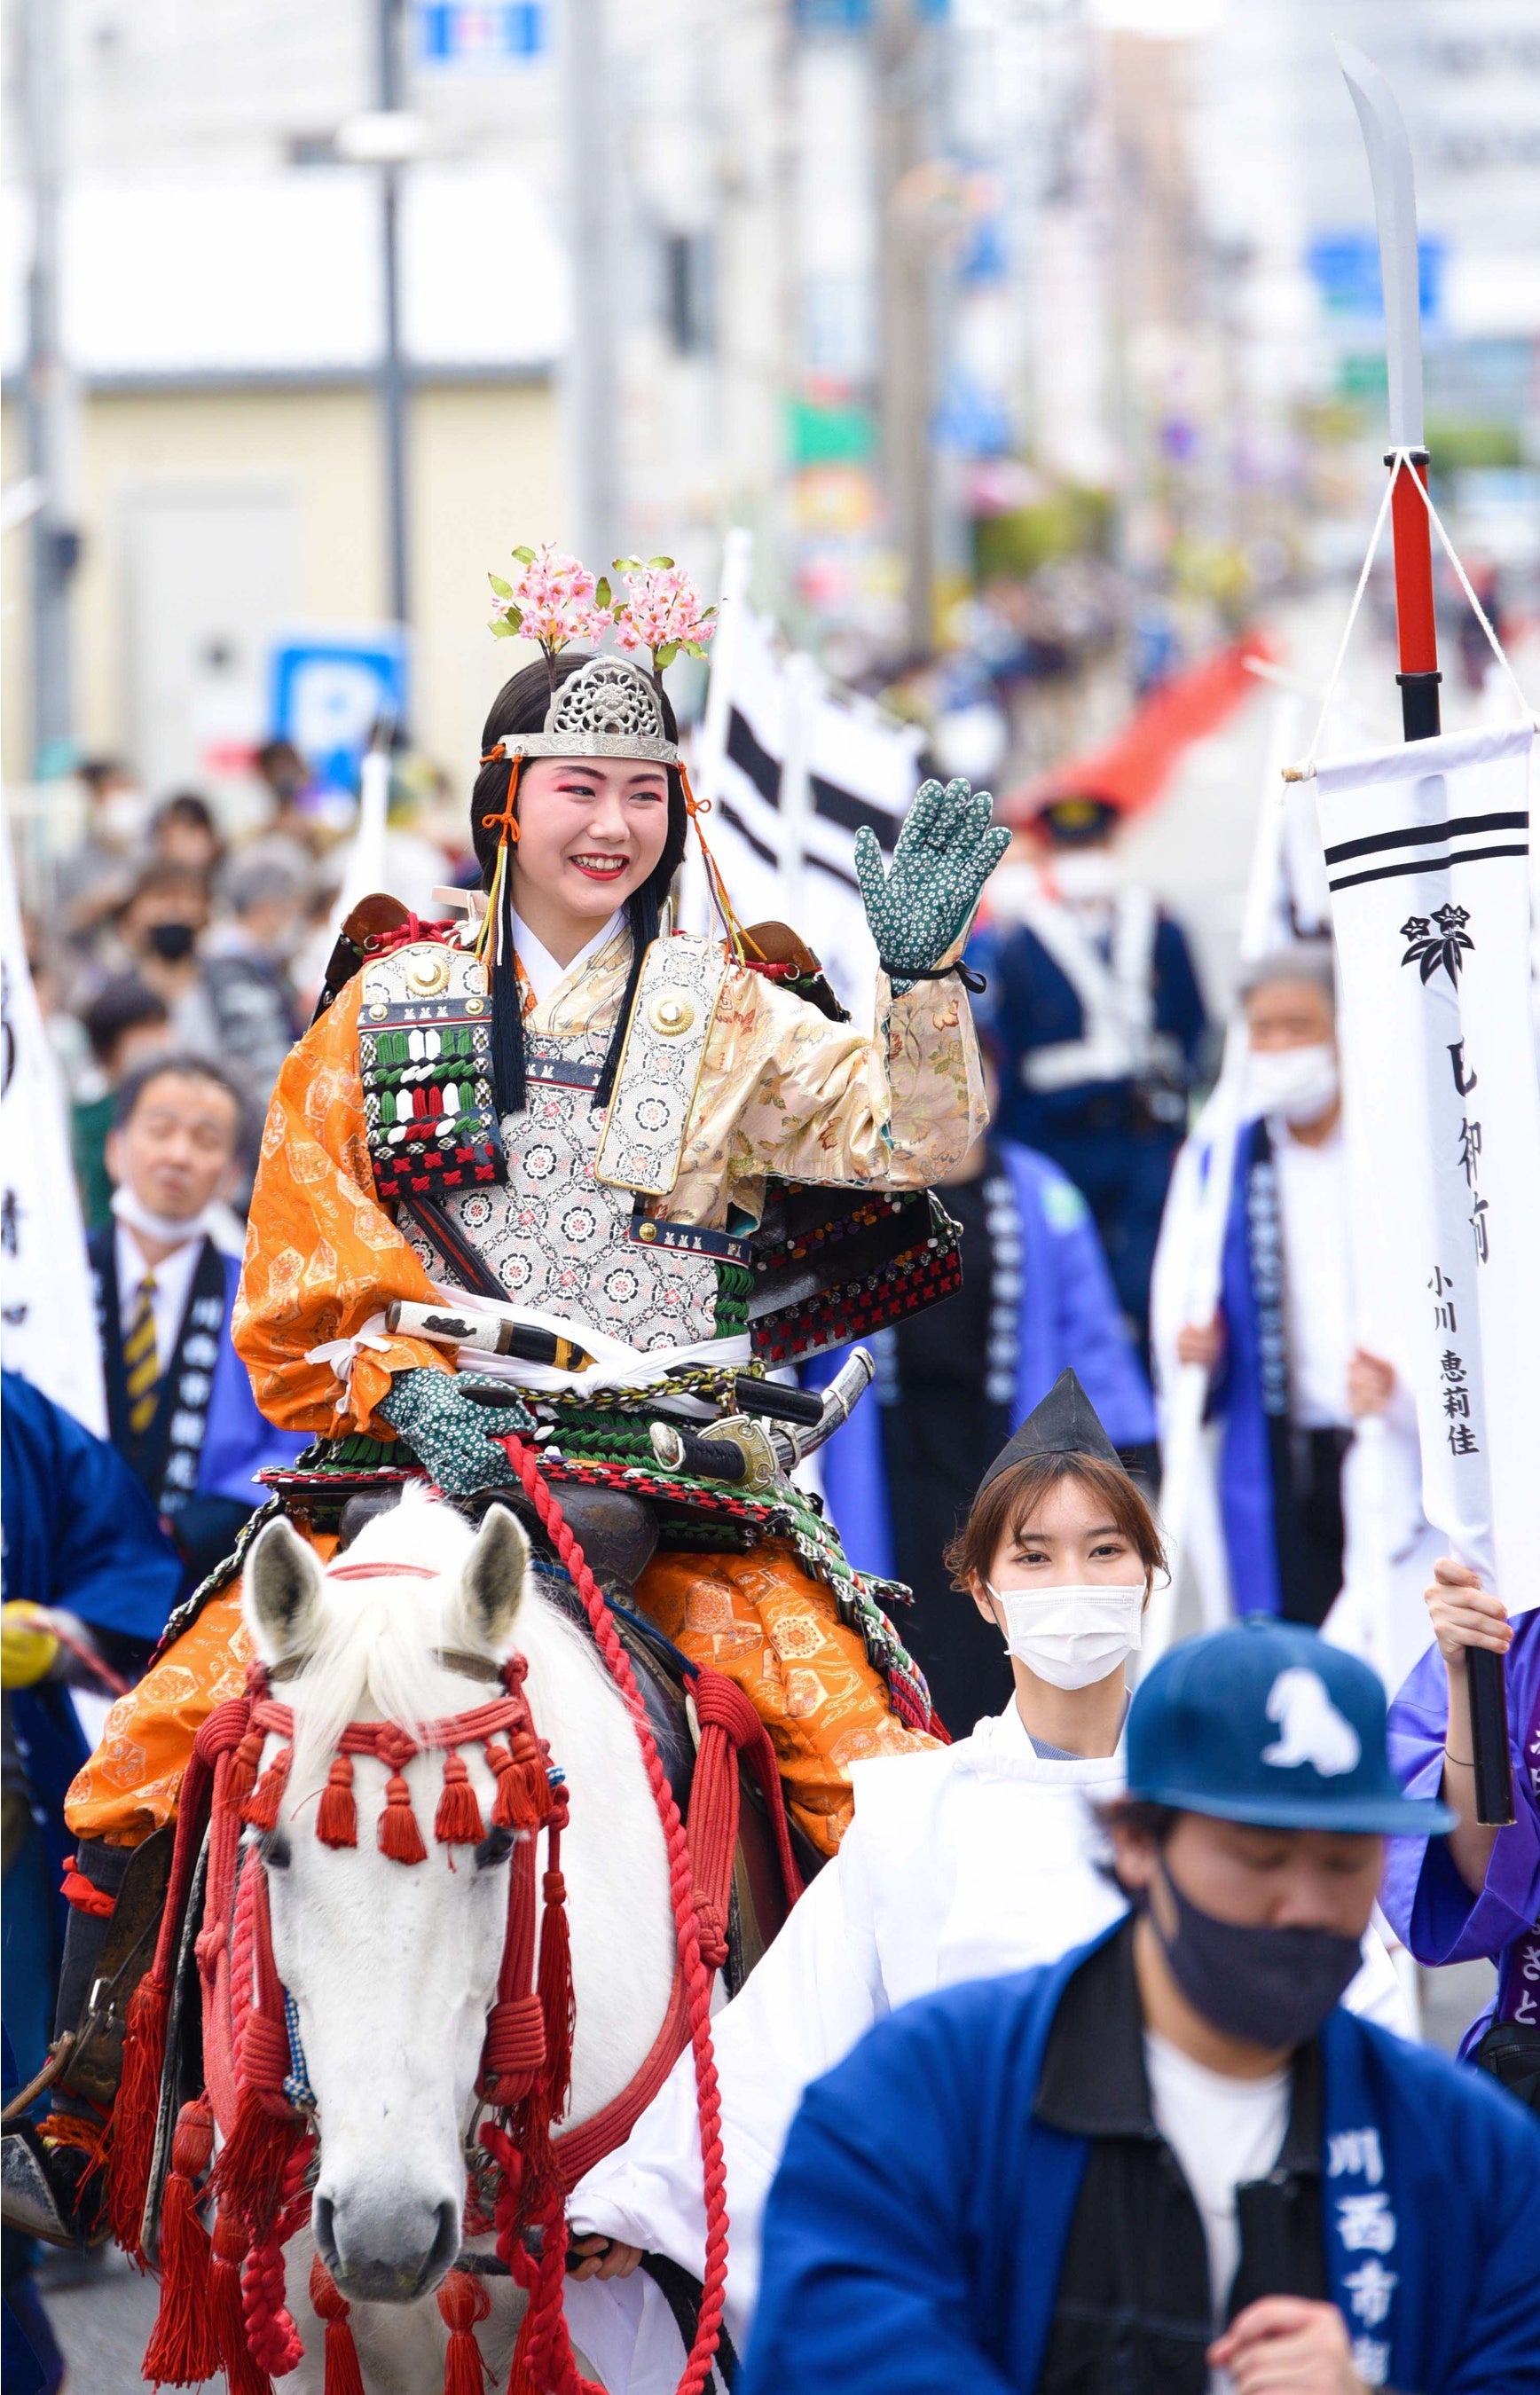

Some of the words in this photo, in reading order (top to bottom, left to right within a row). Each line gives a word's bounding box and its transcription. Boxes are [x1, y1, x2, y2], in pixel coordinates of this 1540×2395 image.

[1426, 1265, 1458, 1333] 小川
[1439, 1349, 1480, 1457] 恵莉佳
